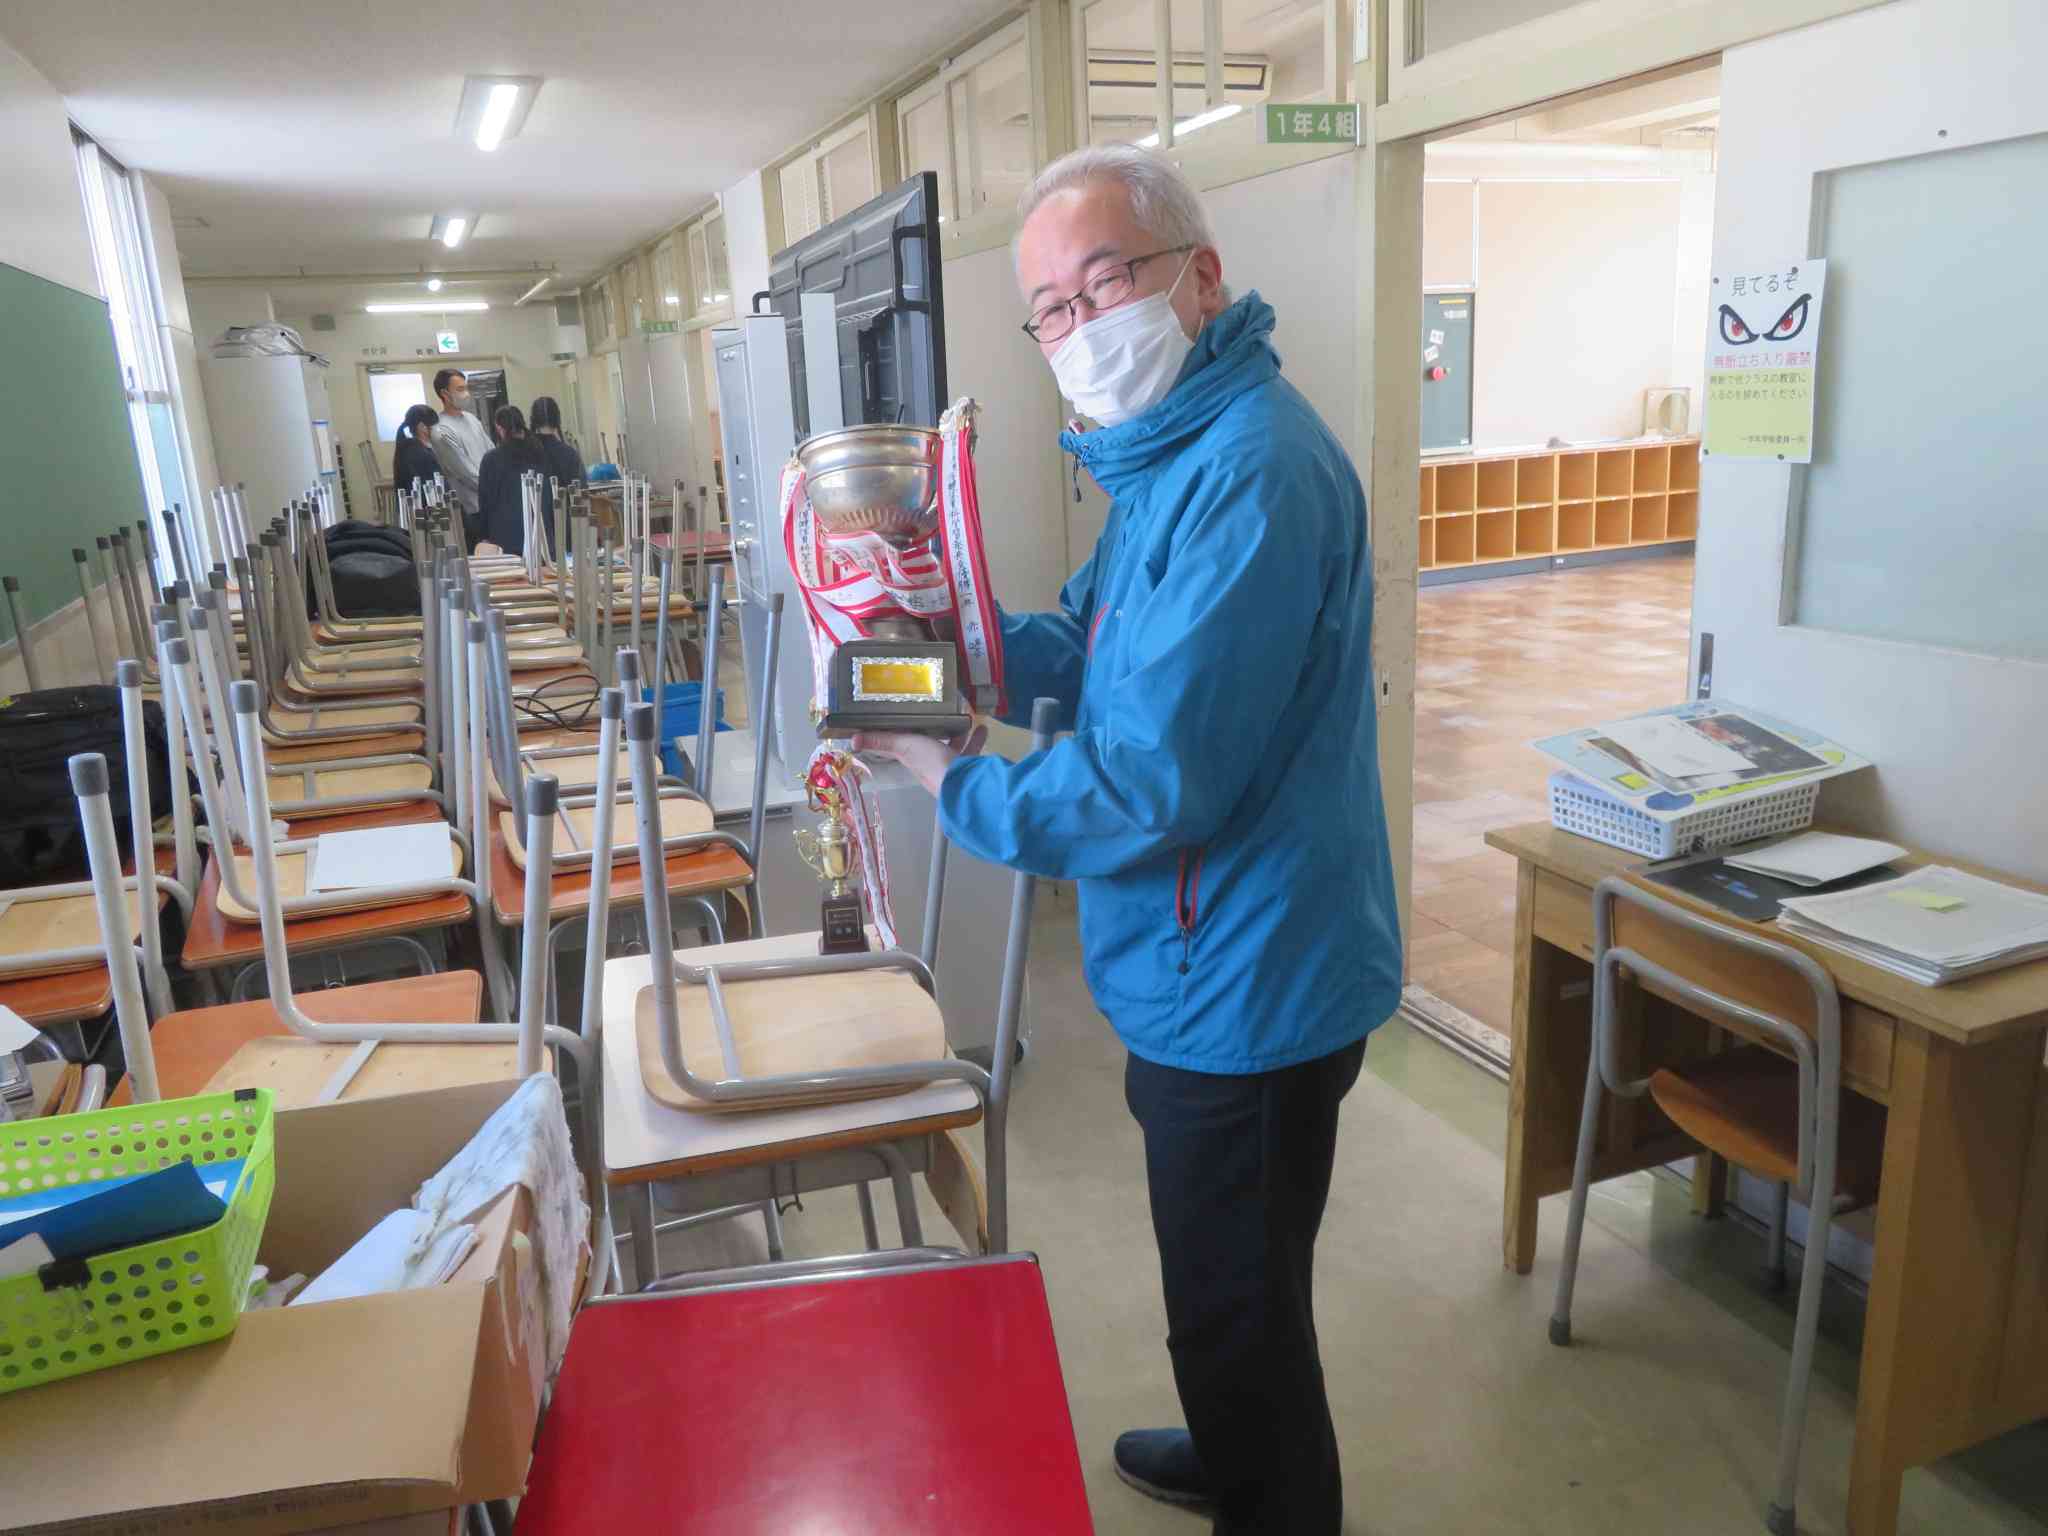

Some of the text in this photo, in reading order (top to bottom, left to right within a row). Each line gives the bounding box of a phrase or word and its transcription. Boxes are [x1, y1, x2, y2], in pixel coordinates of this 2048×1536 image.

[1276, 111, 1355, 137] 1年4組
[1731, 272, 1798, 297] 見てるぞ
